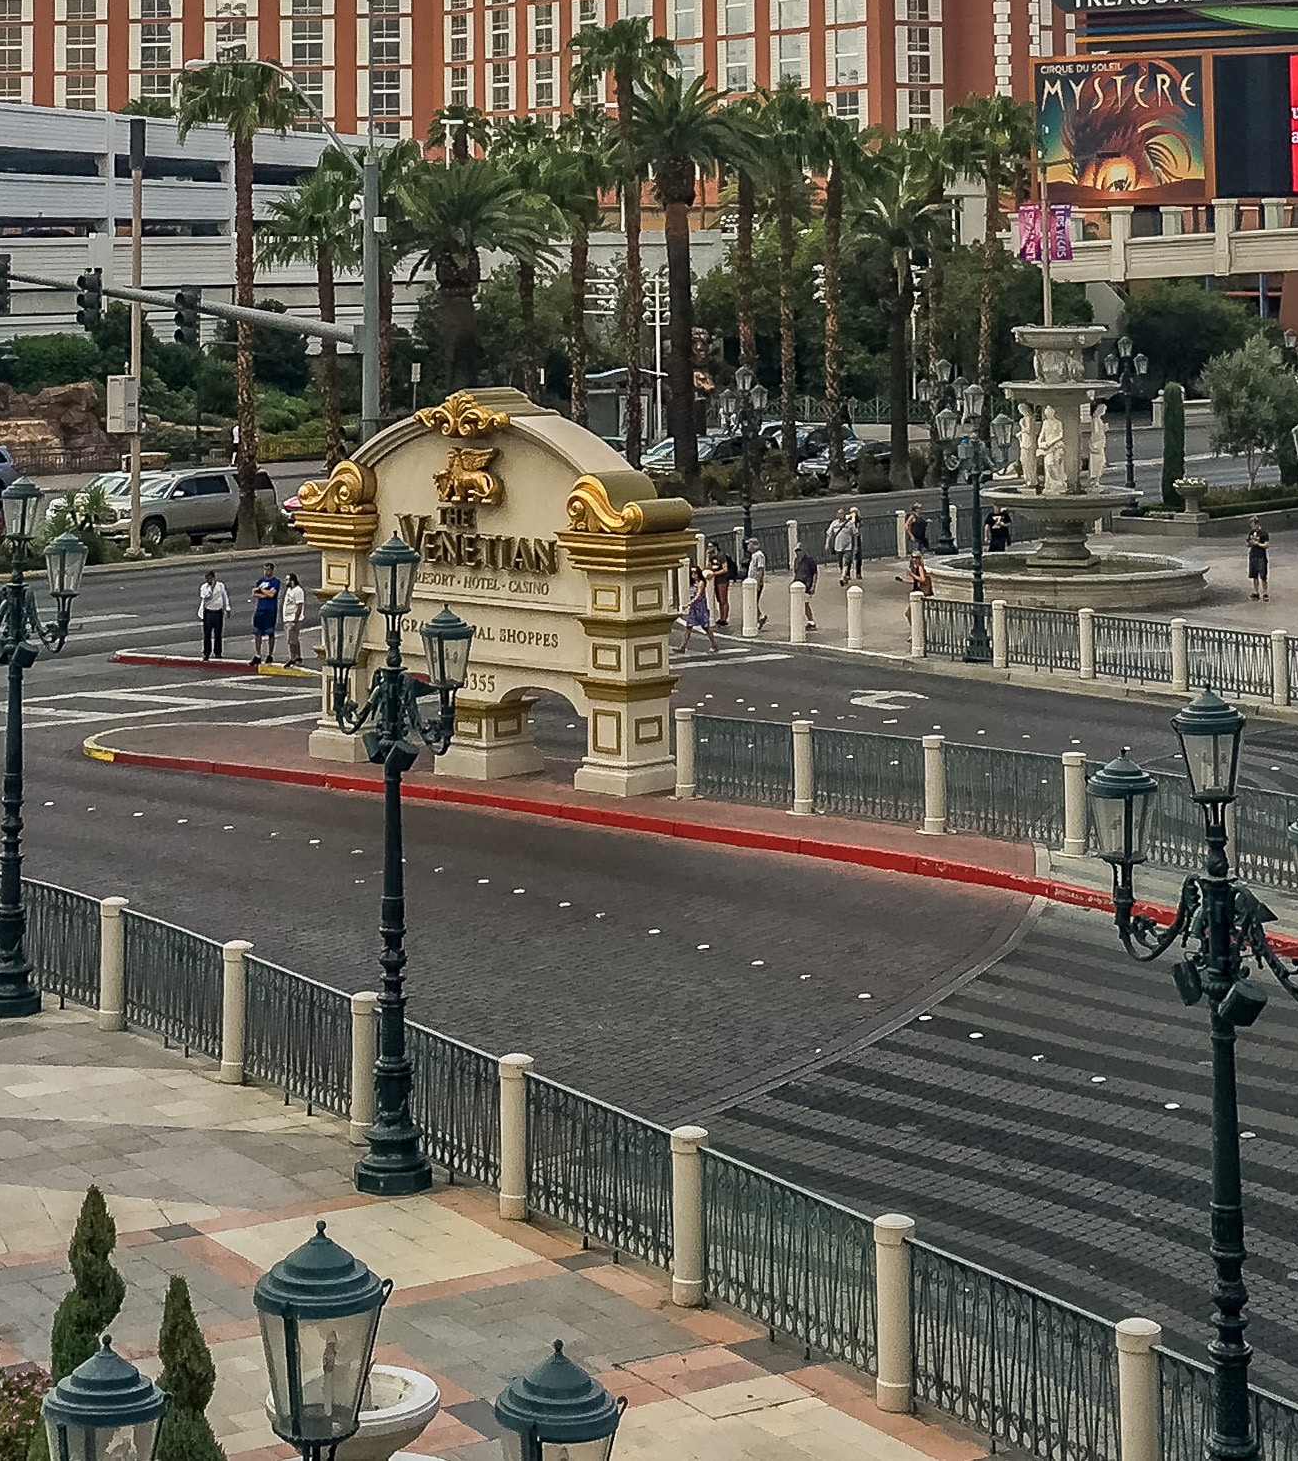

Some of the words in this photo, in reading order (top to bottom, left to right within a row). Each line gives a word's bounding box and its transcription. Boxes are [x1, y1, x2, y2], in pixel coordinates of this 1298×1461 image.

[1041, 64, 1074, 76] CIRQUE
[1076, 63, 1089, 74] DU
[1091, 62, 1122, 72] SOLEIL
[1041, 67, 1196, 112] MYSTÈRE
[437, 506, 477, 528] THE
[394, 513, 559, 575] VENETIAN
[464, 576, 501, 590] HOTEL
[508, 580, 550, 595] CASINO
[499, 628, 559, 648] SHOPPES
